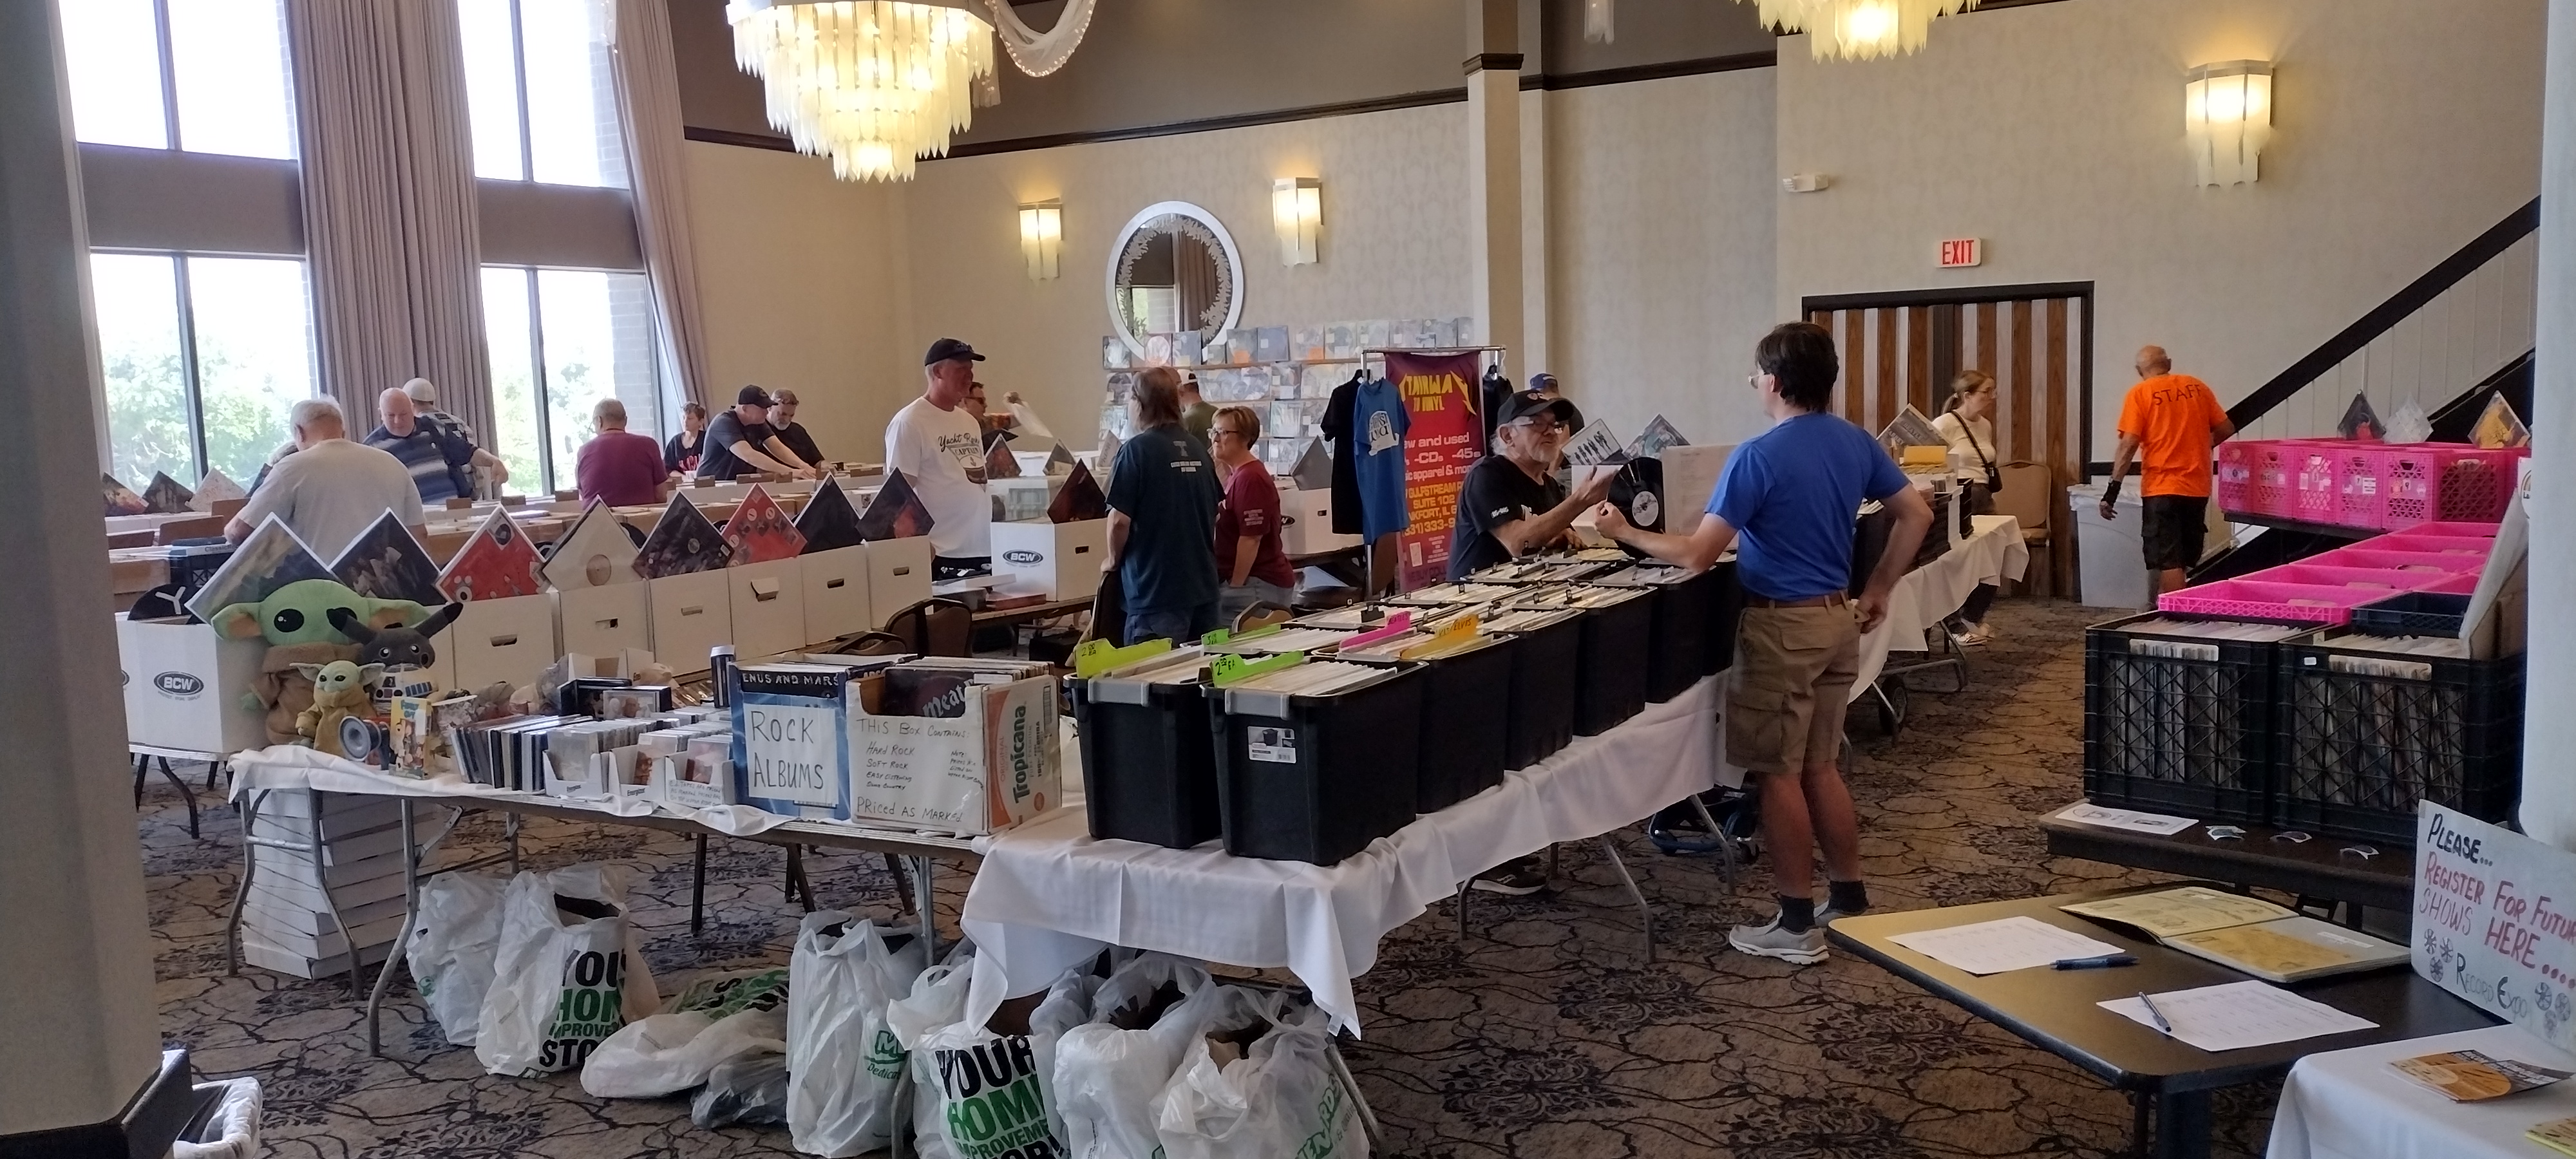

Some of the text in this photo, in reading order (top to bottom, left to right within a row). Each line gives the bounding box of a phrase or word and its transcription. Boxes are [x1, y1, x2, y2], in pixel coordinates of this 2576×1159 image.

[1942, 240, 1975, 265] EXIT
[1422, 395, 1444, 411] VINYL
[2153, 384, 2202, 406] STAFF
[938, 433, 963, 453] Yacht
[1405, 431, 1470, 449] ew and used
[1413, 466, 1444, 482] apparel
[1445, 464, 1454, 476] &
[1454, 464, 1472, 475] mor
[1408, 482, 1457, 499] GULFSTREAM
[1413, 495, 1455, 509] SUITE 102
[1011, 552, 1036, 561] BCW
[1454, 617, 1472, 631] ELVIS
[164, 677, 193, 690] BCW
[743, 674, 839, 686] ENUS AND MARS
[922, 684, 965, 718] Meat
[750, 710, 814, 744] ROCK
[891, 744, 915, 755] ROCK
[1010, 705, 1030, 804] Tropicana
[753, 752, 824, 789] ALBUMS
[866, 759, 909, 770] SOFT ROCK
[902, 806, 915, 817] AS
[2424, 851, 2576, 945] REGISTER FOR FUTUR
[2420, 887, 2473, 936] SHOWS
[2456, 953, 2494, 1009] RECORD
[934, 1037, 1037, 1100] YOUR
